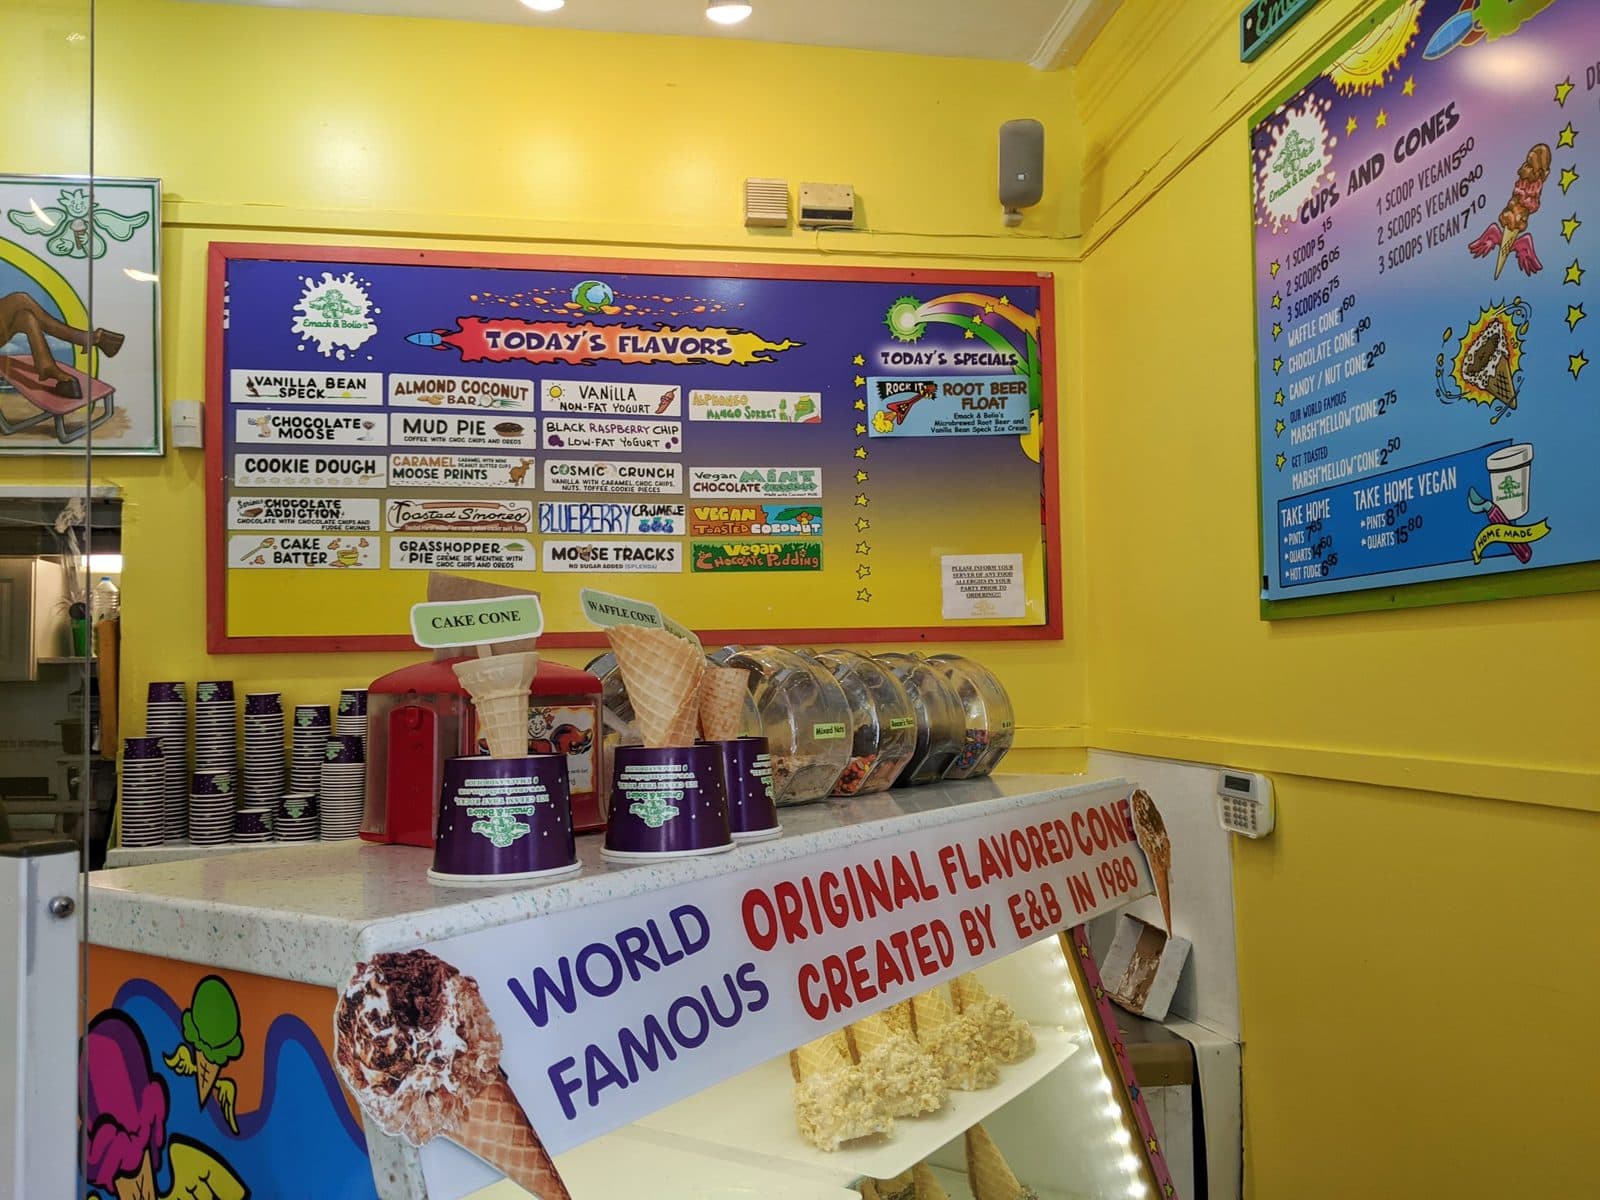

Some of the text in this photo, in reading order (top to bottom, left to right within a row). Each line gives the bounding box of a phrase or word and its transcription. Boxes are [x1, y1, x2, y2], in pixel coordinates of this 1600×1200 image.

[1301, 101, 1459, 224] CUPS AND CONES
[1376, 197, 1382, 215] 1
[1386, 178, 1414, 211] SCOOP
[1418, 155, 1452, 190] VEGAN
[1377, 226, 1384, 246] 2
[1387, 205, 1422, 240] SCOOPS
[1425, 182, 1459, 218] VEGAN
[1378, 256, 1385, 274] 3
[1388, 235, 1422, 269] SCOOPS
[1426, 214, 1460, 248] VEGAN
[1285, 254, 1290, 270] 1
[1293, 239, 1316, 267] SCOOP
[1286, 279, 1291, 297] 2
[1294, 262, 1322, 293] SCOOPS
[1287, 306, 1292, 323] 3
[1295, 289, 1322, 319] SCOOPS
[303, 320, 332, 328] Emack
[333, 320, 340, 328] &
[1288, 320, 1317, 348] WAFFLE
[1318, 308, 1340, 333] CONE
[485, 330, 733, 355] TODAY'S FLAVORS
[881, 350, 1019, 367] TODAY'S SPECIALS
[1288, 339, 1332, 375] CHOCOLATE
[1334, 328, 1356, 354] CONE
[254, 376, 367, 390] VANILLA BEAN
[1289, 374, 1315, 401] CANDY
[1324, 363, 1342, 387] NUT
[1344, 352, 1367, 379] CONE
[279, 387, 326, 399] SPECK
[394, 379, 529, 401] ALMOND COCONUT
[885, 382, 924, 397] ROCK IT
[943, 381, 1028, 396] ROOT BEER
[447, 395, 477, 406] BAR
[560, 402, 651, 414] NON-FAT YOGURT
[962, 397, 1009, 411] FLOAT
[1290, 390, 1347, 423] OUR WORLD FAMOUS
[706, 408, 742, 420] MANGO
[271, 416, 361, 429] CHOCOLATE
[403, 418, 486, 436] MUD PIE
[546, 422, 679, 435] BLACK RASPBERRY CHIP
[278, 427, 335, 440] MOOSE
[567, 437, 660, 448] LOW-FAT YOGURT
[392, 456, 456, 468] CARAMEL
[1291, 446, 1328, 469] GET TOASTED
[245, 458, 376, 474] COOKIE DOUGH
[392, 467, 488, 480] MOOSE PRINTS
[550, 464, 675, 478] COSMIC CRUNCH
[694, 472, 738, 482] Vegan
[693, 482, 761, 493] CHOCOLATE
[1353, 466, 1457, 511] TAKE HOME VEGAN
[264, 499, 342, 509] CHOCOLATE
[394, 500, 456, 524] Toasted
[264, 508, 341, 519] ADDICTION
[539, 503, 632, 534] BLUEBERRY
[694, 506, 757, 521] VEGAN
[1280, 498, 1331, 529] TAKE HOME
[750, 523, 821, 534] COCONUT
[1366, 513, 1386, 531] PINTS
[280, 537, 321, 550] CAKE
[1288, 531, 1305, 546] PINTS
[1367, 531, 1395, 550] QUARTS
[1477, 528, 1533, 548] HOME MADE
[399, 540, 501, 554] GRASSHOPPER
[613, 547, 675, 561] TRACKS
[723, 543, 783, 556] Vegan
[1289, 547, 1312, 563] QUARTS
[273, 551, 328, 564] BATTER
[409, 553, 433, 564] PIE
[1289, 563, 1322, 581] HOT FUDGE
[431, 610, 521, 629] CAKE CONE
[587, 600, 657, 625] WAFFLE CONE
[742, 850, 939, 952] ORIGINAL
[938, 819, 1073, 895] FLAVORED
[798, 856, 1138, 1021] CREATED BY E&B IN 1980
[507, 904, 710, 1028] WORLD
[547, 962, 769, 1121] FAMOUS
